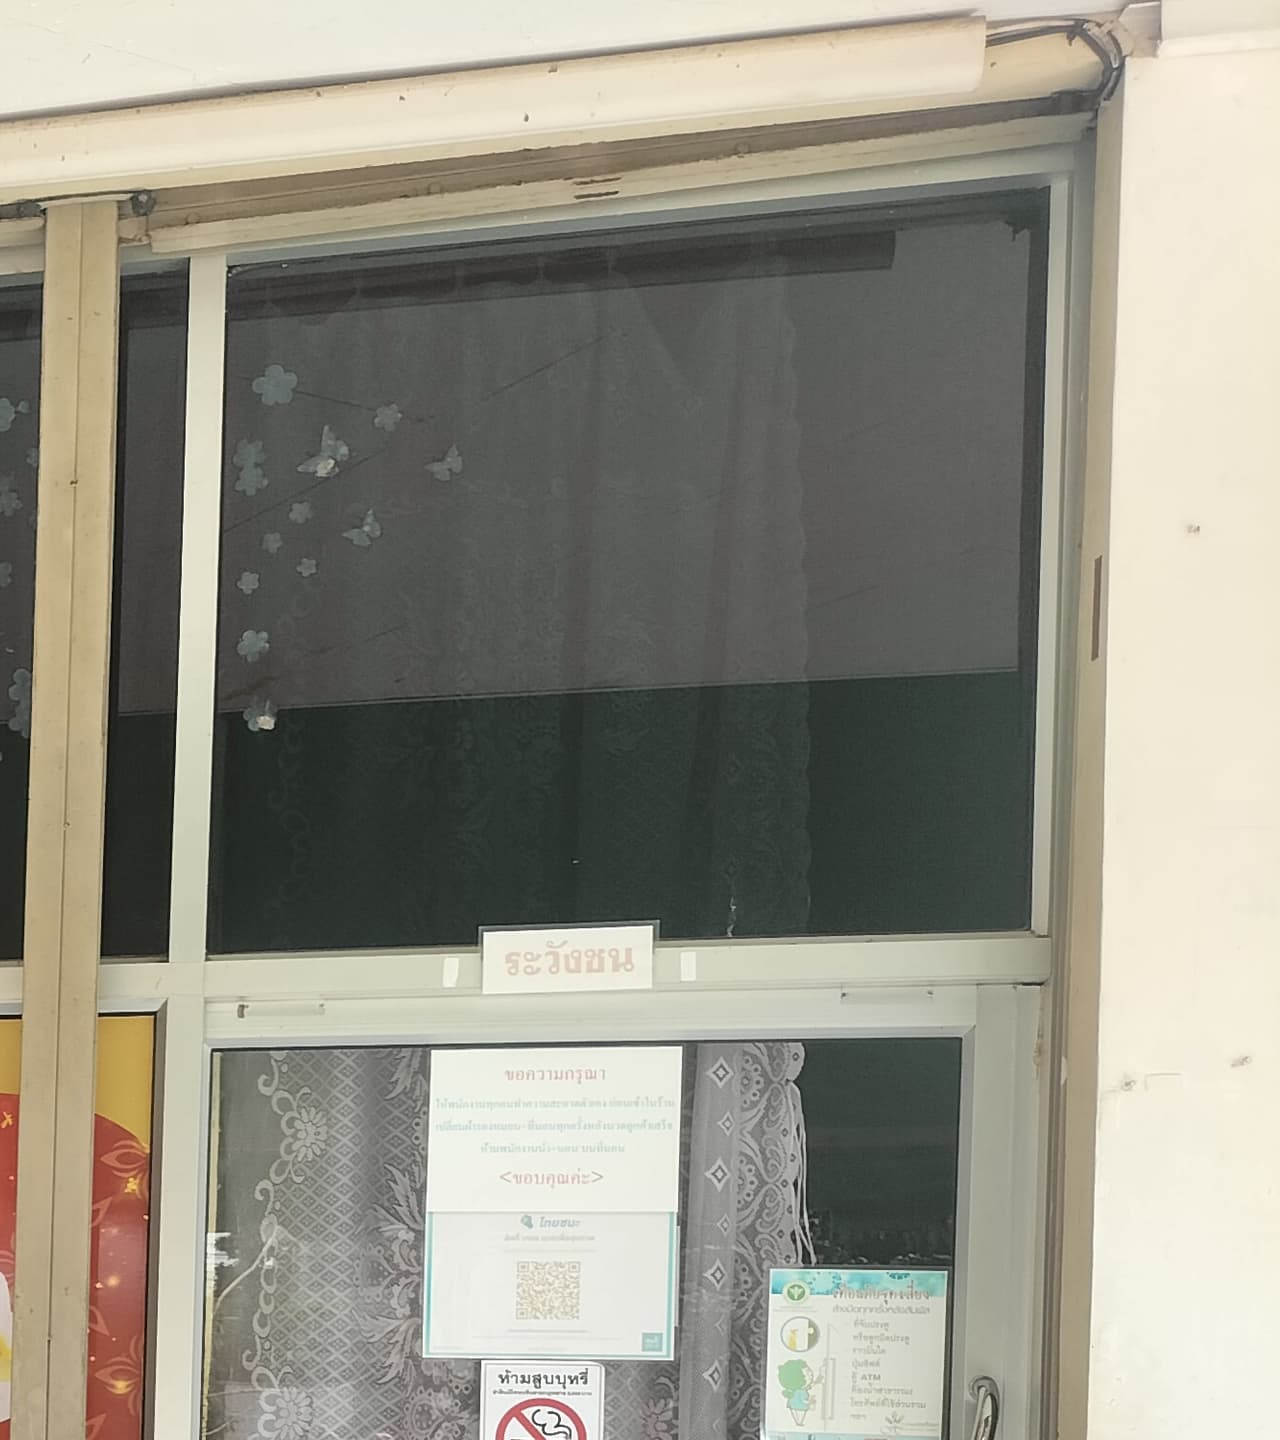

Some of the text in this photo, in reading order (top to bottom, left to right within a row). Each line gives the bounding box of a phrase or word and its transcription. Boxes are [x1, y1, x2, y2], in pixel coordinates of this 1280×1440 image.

[504, 940, 635, 976] ระวังชน
[504, 1066, 607, 1085] ขอความกรุณา
[498, 1367, 589, 1389] ห้ามสูบบุหรี่
